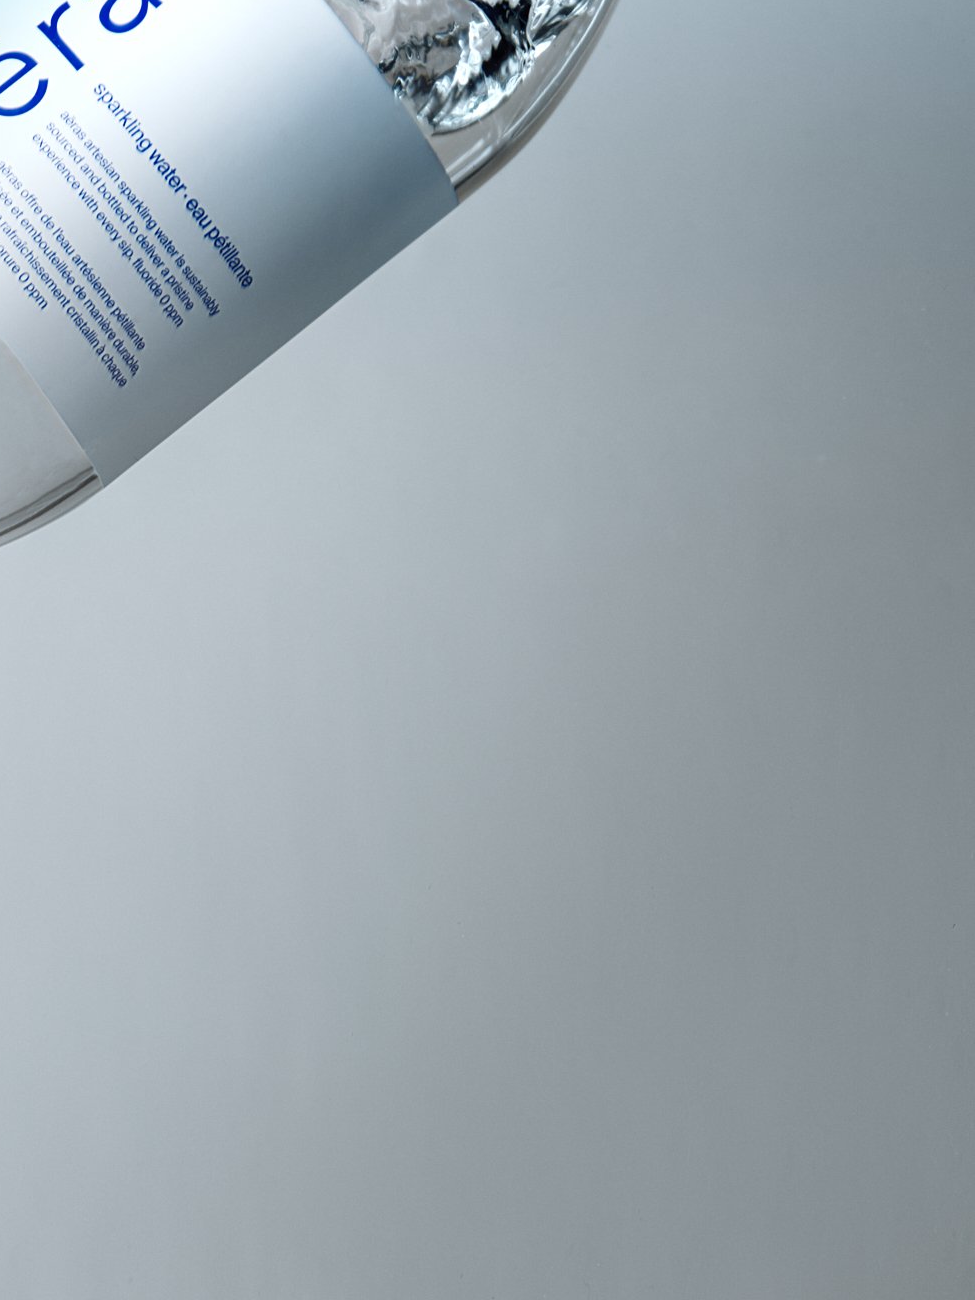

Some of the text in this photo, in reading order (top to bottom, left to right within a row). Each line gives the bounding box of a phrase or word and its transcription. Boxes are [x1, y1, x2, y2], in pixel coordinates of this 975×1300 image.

[32, 133, 80, 190] experience
[94, 83, 152, 153] sparkling
[149, 148, 187, 194] water
[185, 198, 212, 230] eau
[204, 226, 253, 288] pétillante
[46, 122, 194, 310] sourced and bottled to deliver a pristine
[78, 188, 98, 213] with
[84, 140, 120, 183] artesian
[118, 180, 157, 230] sparkling
[154, 227, 179, 257] water
[175, 254, 185, 267] is
[182, 266, 220, 317] sustainably
[96, 212, 122, 241] every
[10, 206, 24, 219] et
[20, 219, 75, 285] embouteillée
[73, 284, 87, 300] de
[83, 299, 116, 340] manière
[112, 338, 139, 377] durable,
[18, 271, 30, 283] 0
[20, 190, 43, 215] offre
[40, 214, 55, 230] de
[71, 254, 115, 308] artésienne
[110, 307, 145, 350] pétillante
[132, 258, 162, 297] fluoride
[0, 221, 71, 308] rafraîchissement
[66, 306, 100, 349] cristallin
[96, 344, 106, 355] à
[101, 353, 127, 387] chaque
[23, 282, 48, 310] ppm
[159, 294, 171, 305] 0
[163, 303, 184, 328] ppm
